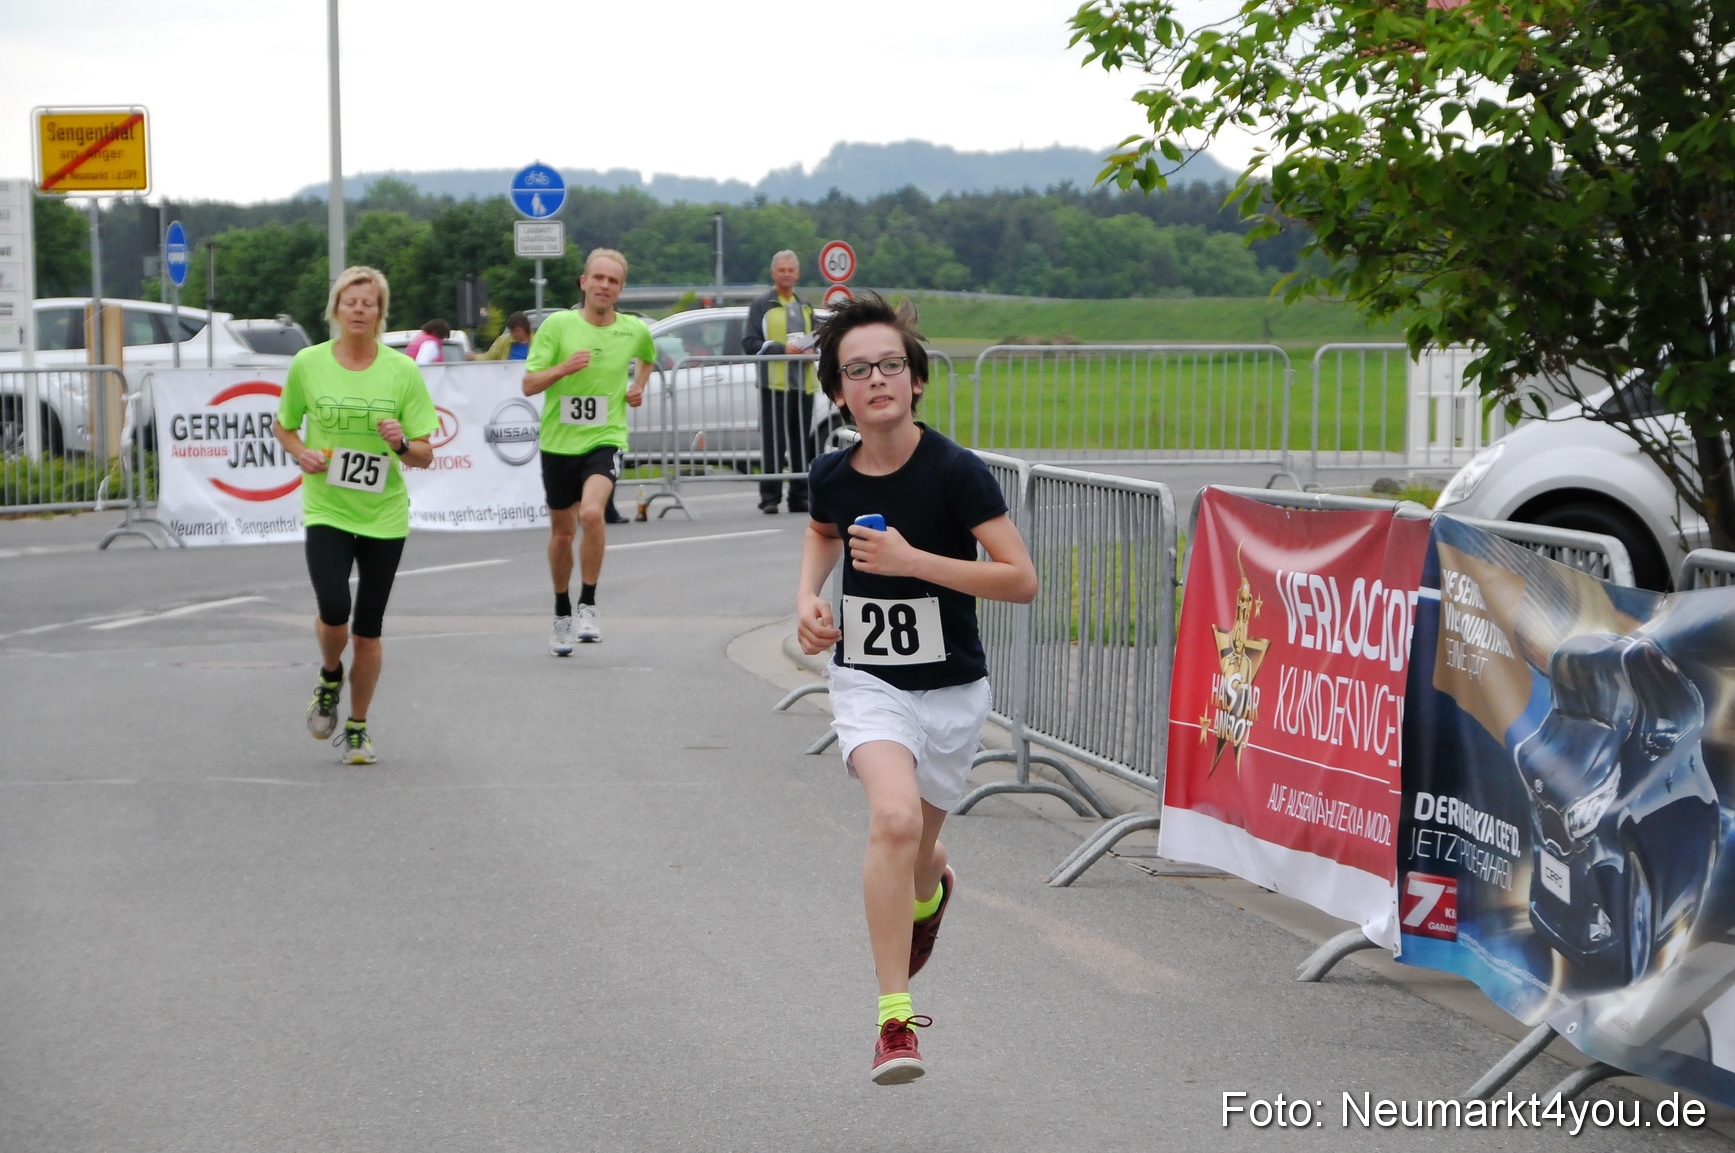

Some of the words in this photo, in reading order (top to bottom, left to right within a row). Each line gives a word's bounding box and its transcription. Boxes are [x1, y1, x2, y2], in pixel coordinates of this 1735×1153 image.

[47, 121, 135, 146] Sengenthal
[828, 253, 847, 271] 60
[570, 396, 597, 420] 39
[170, 412, 278, 441] GERHAR
[171, 444, 229, 458] Autohaus
[227, 440, 301, 469] JÄNI
[417, 455, 471, 472] OTORS
[340, 451, 381, 486] 125
[168, 519, 230, 537] Neumarkt
[235, 515, 299, 537] Sengenthal
[861, 602, 920, 657] 28
[1267, 782, 1288, 812] AUF
[1414, 791, 1459, 826] DER
[1472, 811, 1495, 845] KIA
[1403, 880, 1446, 928] 7
